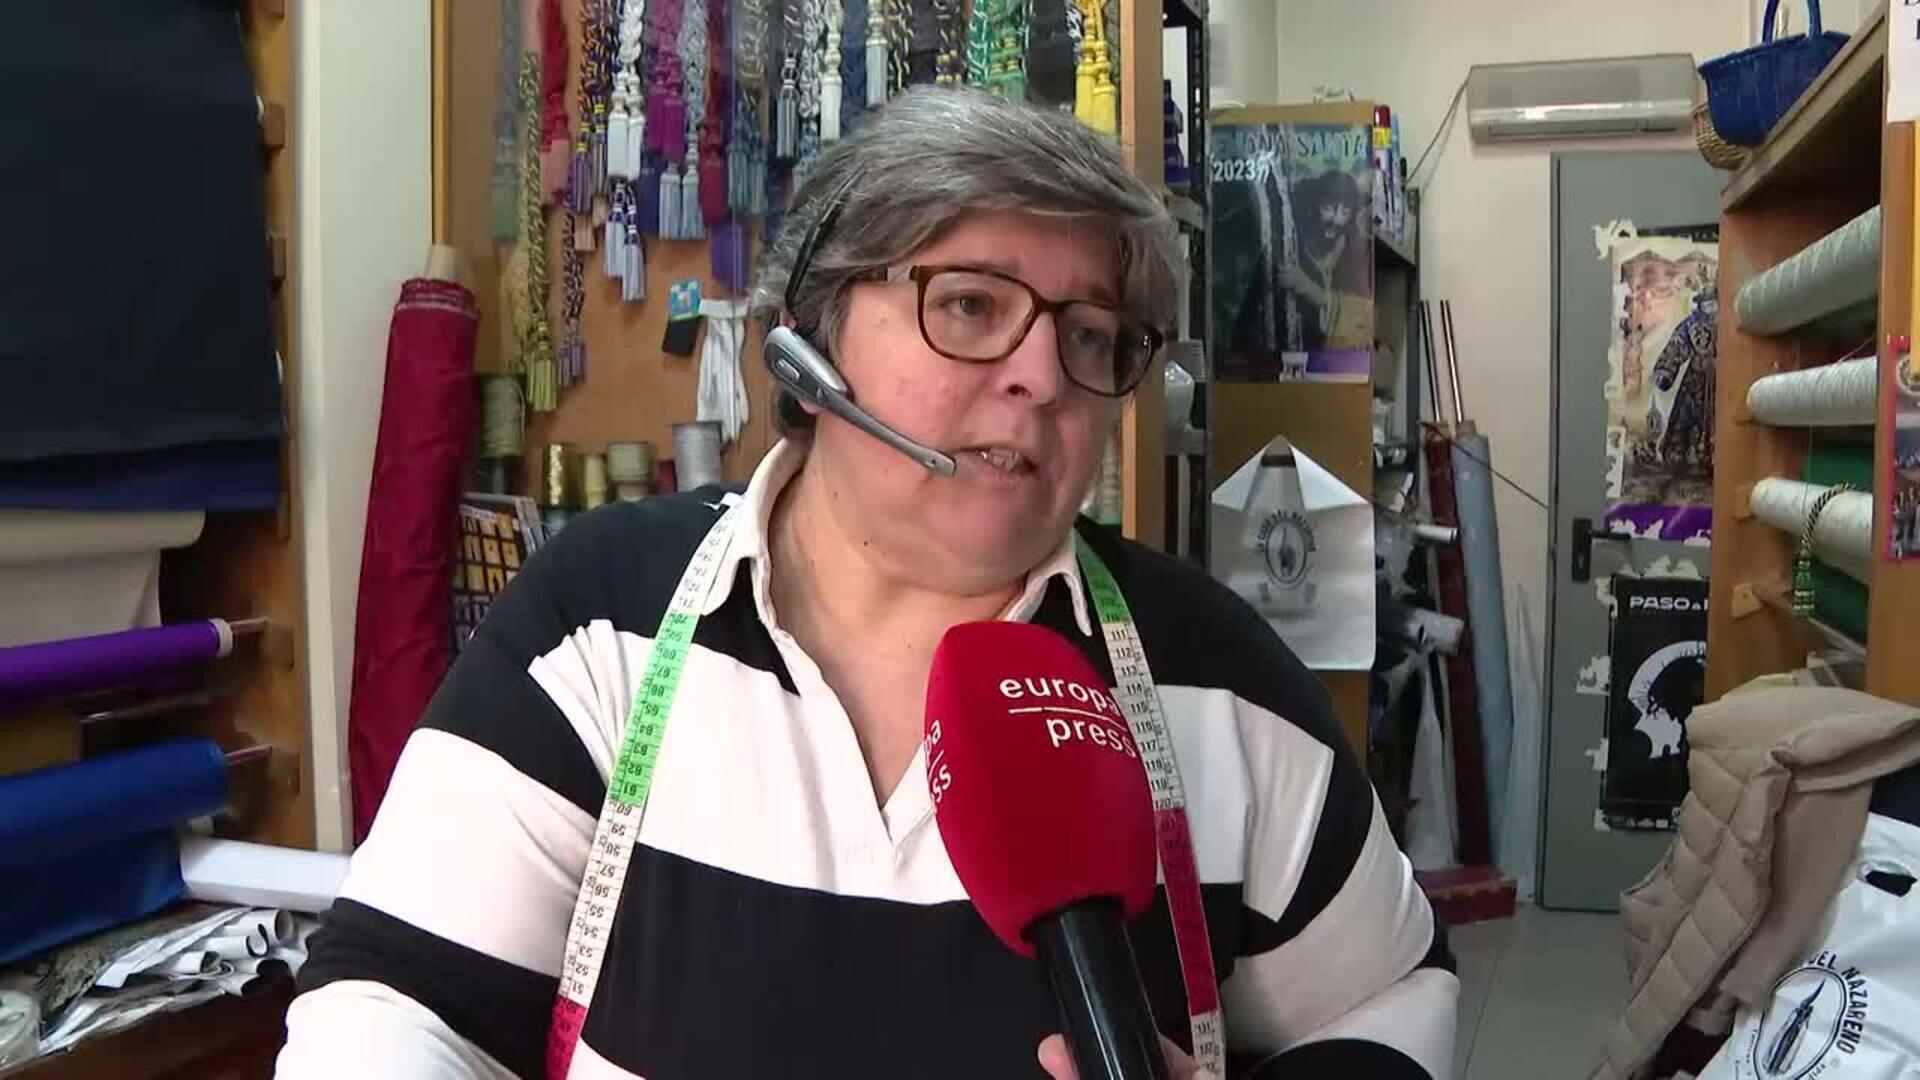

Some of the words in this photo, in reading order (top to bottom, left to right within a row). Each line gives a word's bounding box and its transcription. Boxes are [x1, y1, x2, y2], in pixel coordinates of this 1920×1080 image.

[1213, 158, 1256, 182] 2023
[1630, 595, 1690, 610] PASO
[1046, 718, 1137, 758] press
[628, 762, 642, 776] 62
[624, 782, 637, 796] 61
[616, 803, 632, 816] 60
[600, 863, 616, 878] 57
[1836, 966, 1868, 1054] NAZARENO
